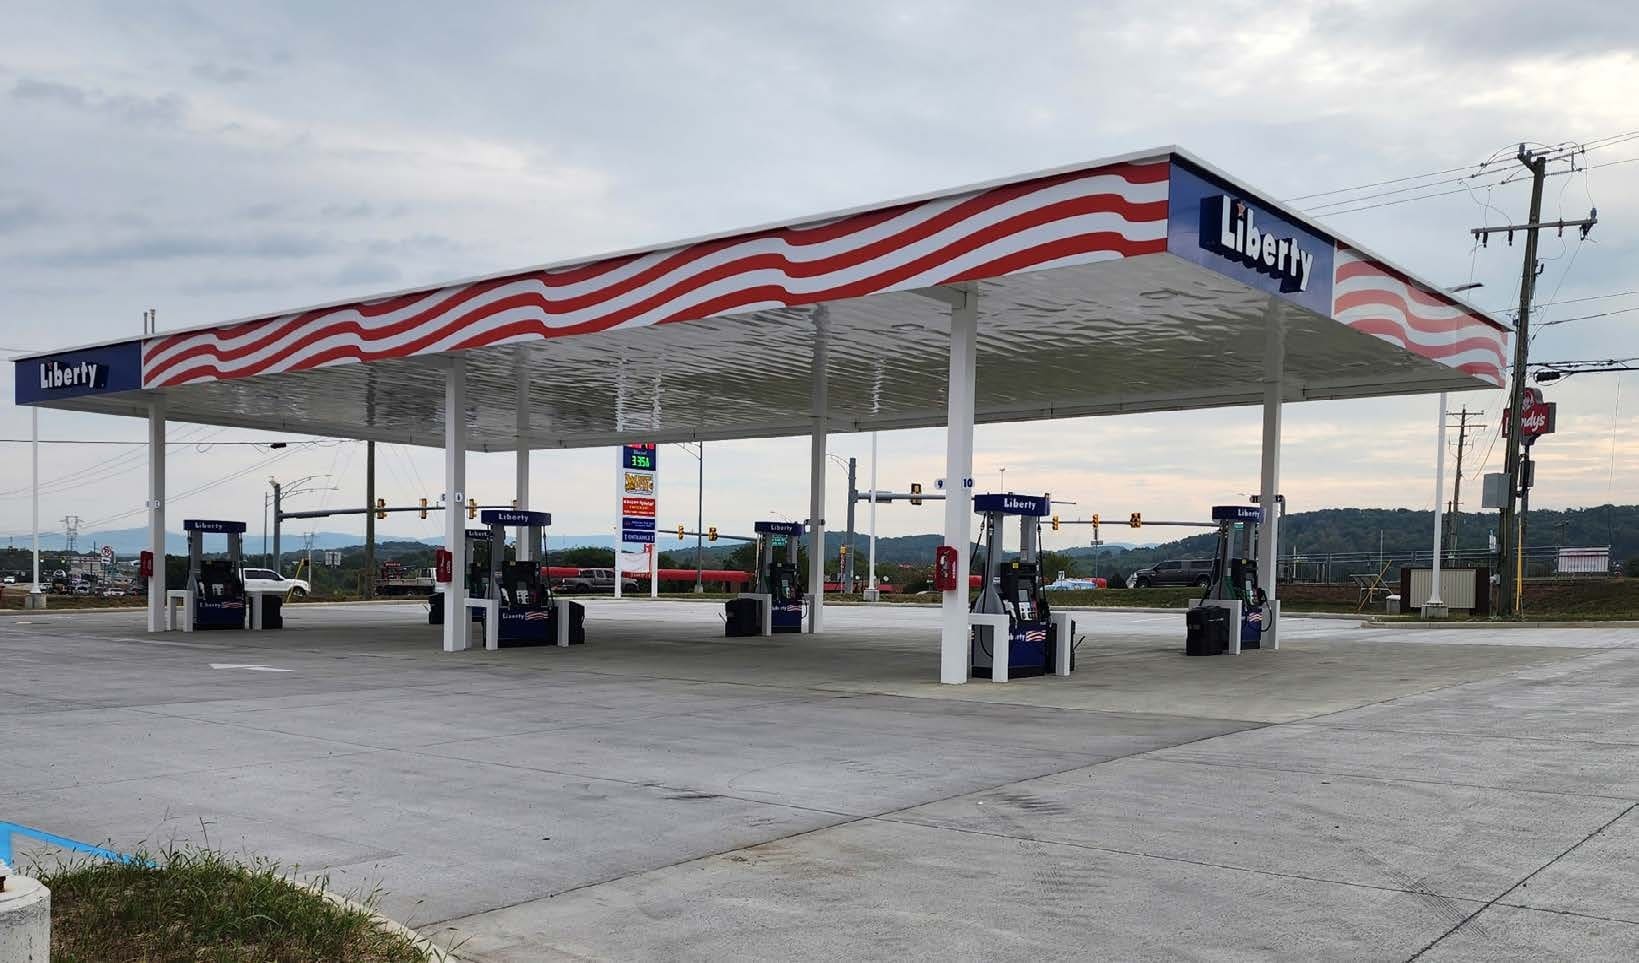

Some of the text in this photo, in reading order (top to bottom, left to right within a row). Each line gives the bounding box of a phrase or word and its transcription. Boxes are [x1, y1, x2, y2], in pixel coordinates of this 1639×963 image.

[1221, 195, 1313, 291] Liberty
[40, 361, 97, 388] Liberty
[963, 479, 972, 487] 10
[1003, 498, 1036, 510] Liberty
[498, 513, 528, 522] Liberty
[1237, 509, 1260, 519] Liberty
[194, 522, 222, 530] Liberty
